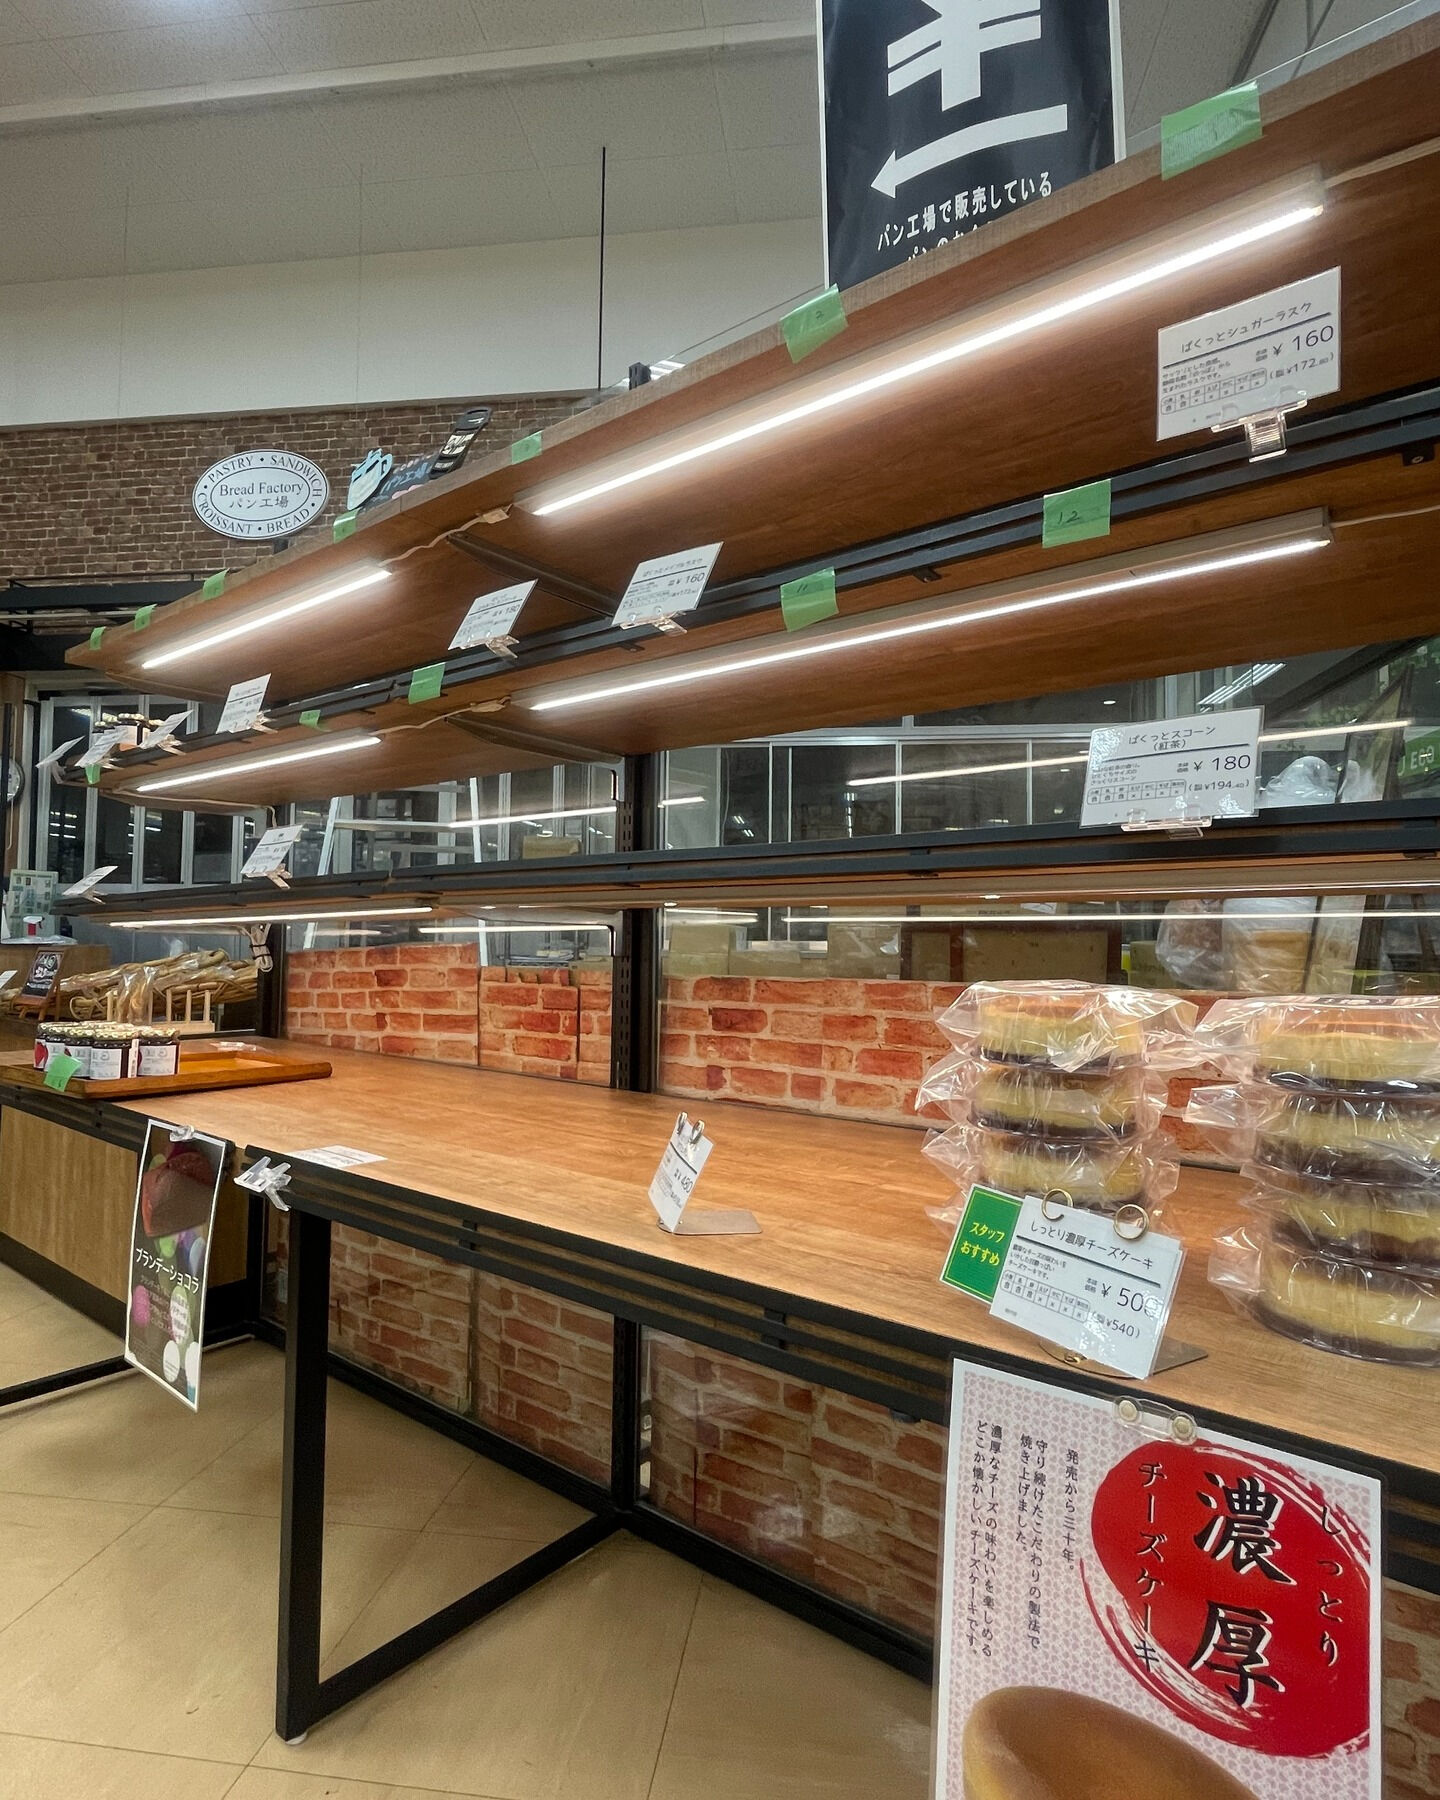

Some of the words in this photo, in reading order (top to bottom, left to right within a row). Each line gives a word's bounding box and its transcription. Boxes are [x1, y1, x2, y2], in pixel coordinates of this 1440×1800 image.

[877, 171, 1053, 251] パン工場で販売している
[1181, 302, 1312, 353] ぱくっとシュガーラスク
[1292, 325, 1334, 351] 160
[208, 456, 254, 483] PASTRY
[269, 455, 323, 497] SANDWICH
[219, 483, 254, 496] Bread
[259, 482, 304, 495] Factory
[197, 492, 253, 535] CROISSANT
[266, 509, 310, 533] BREAD
[229, 496, 289, 509] パン工場
[1128, 726, 1216, 745] ぱくっとスコーン
[1153, 740, 1186, 751] (紅茶)
[1212, 755, 1251, 771] 180
[960, 1241, 1001, 1267] おすすめ
[969, 1221, 1005, 1242] スタッフ
[1031, 1220, 1154, 1271] しっとり濃厚チーズケーキ
[1016, 1434, 1033, 1552] 焼き上げました。
[1061, 1448, 1079, 1572] 発売から三十年。
[967, 1420, 989, 1656] どこか懐かしいチーズケーキです。
[981, 1424, 1002, 1658] 濃厚なチーズの味わいを楽しめる
[1028, 1439, 1048, 1650] 守り続けたこだわりの製法で
[1134, 1462, 1168, 1673] チーズケーキ
[1187, 1471, 1297, 1709] 濃厚
[1318, 1504, 1343, 1668] しっとり
